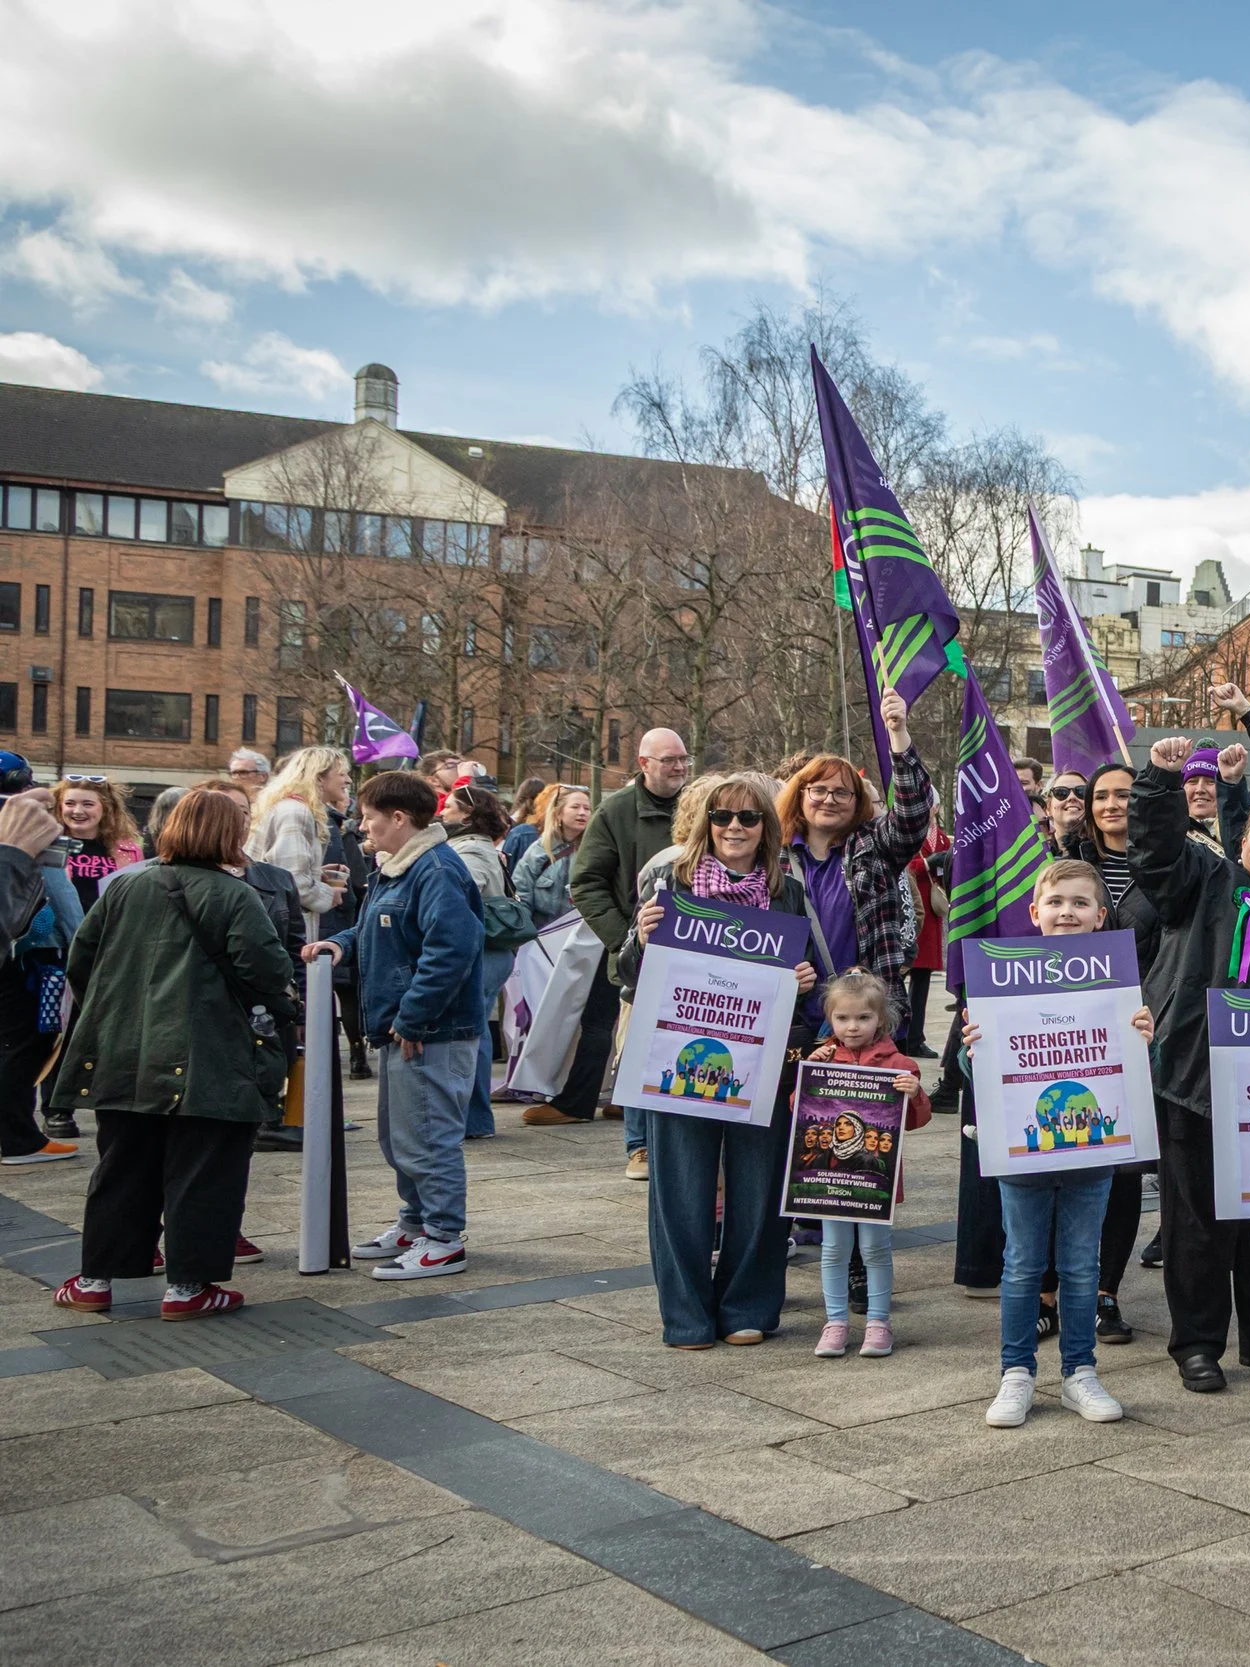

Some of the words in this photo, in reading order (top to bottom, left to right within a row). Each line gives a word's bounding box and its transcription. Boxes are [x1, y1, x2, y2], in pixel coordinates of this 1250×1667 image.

[674, 916, 783, 956] UNISON
[991, 954, 1111, 987] UNISON
[708, 978, 738, 989] UNISON
[673, 987, 743, 1012] STRENGTH
[747, 1000, 761, 1014] IN
[676, 1004, 756, 1030] SOLIDARITY
[1042, 1015, 1075, 1026] UNISON
[667, 1023, 705, 1035] INTERNATIONAL
[730, 1033, 740, 1041] DAY
[1009, 1029, 1086, 1051] STRENGTH
[1092, 1027, 1108, 1043] IN
[1018, 1045, 1107, 1068] SOLIDARITY
[811, 1069, 825, 1077] ALL
[826, 1070, 857, 1080] WOMEN
[1012, 1073, 1056, 1083] INTERNATIONAL
[1057, 1069, 1084, 1079] WOMEN'S
[1085, 1068, 1097, 1077] DAY
[1097, 1066, 1113, 1075] 2026
[828, 1079, 880, 1090] OPPRESSION
[819, 1087, 846, 1097] STAND
[847, 1090, 856, 1098] IN
[858, 1091, 886, 1101] UNITY!
[817, 1171, 850, 1179] SOLIDARITY
[832, 1177, 877, 1189] EVERYWHERE
[793, 1197, 840, 1206] INTERNATIONAL
[841, 1201, 868, 1210] WOMEN'S
[869, 1203, 882, 1211] DAY
